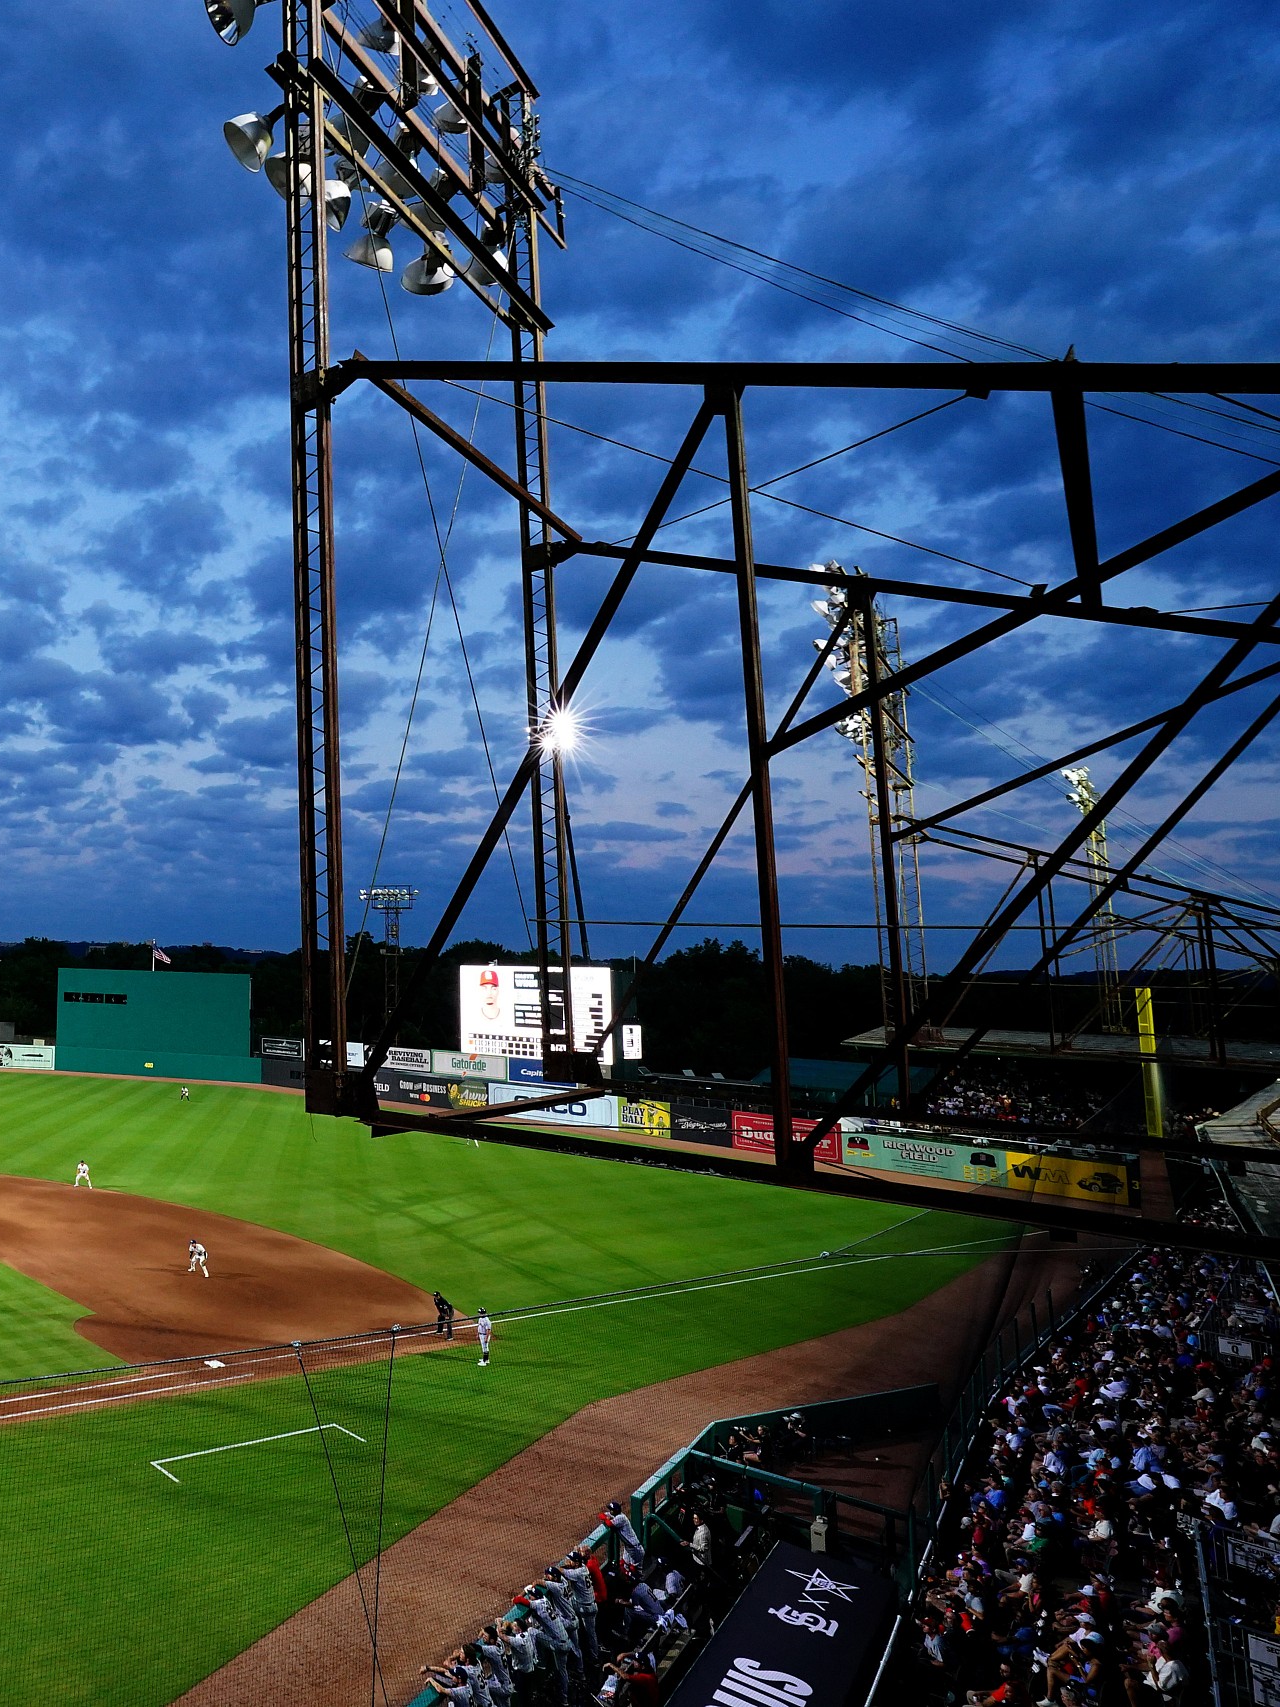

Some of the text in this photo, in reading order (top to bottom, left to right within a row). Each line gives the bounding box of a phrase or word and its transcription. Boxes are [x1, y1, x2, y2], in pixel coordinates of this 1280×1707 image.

[392, 1056, 429, 1064] BASEBALL
[452, 1058, 486, 1071] Gatorade
[521, 1068, 543, 1077] Capit
[400, 1080, 413, 1090] GROW
[423, 1082, 447, 1094] BUSINESS
[622, 1106, 645, 1116] PLAY
[622, 1114, 645, 1125] BALL
[883, 1140, 956, 1157] RICKWOOD
[901, 1150, 939, 1163] FIELD
[1012, 1164, 1071, 1185] WM
